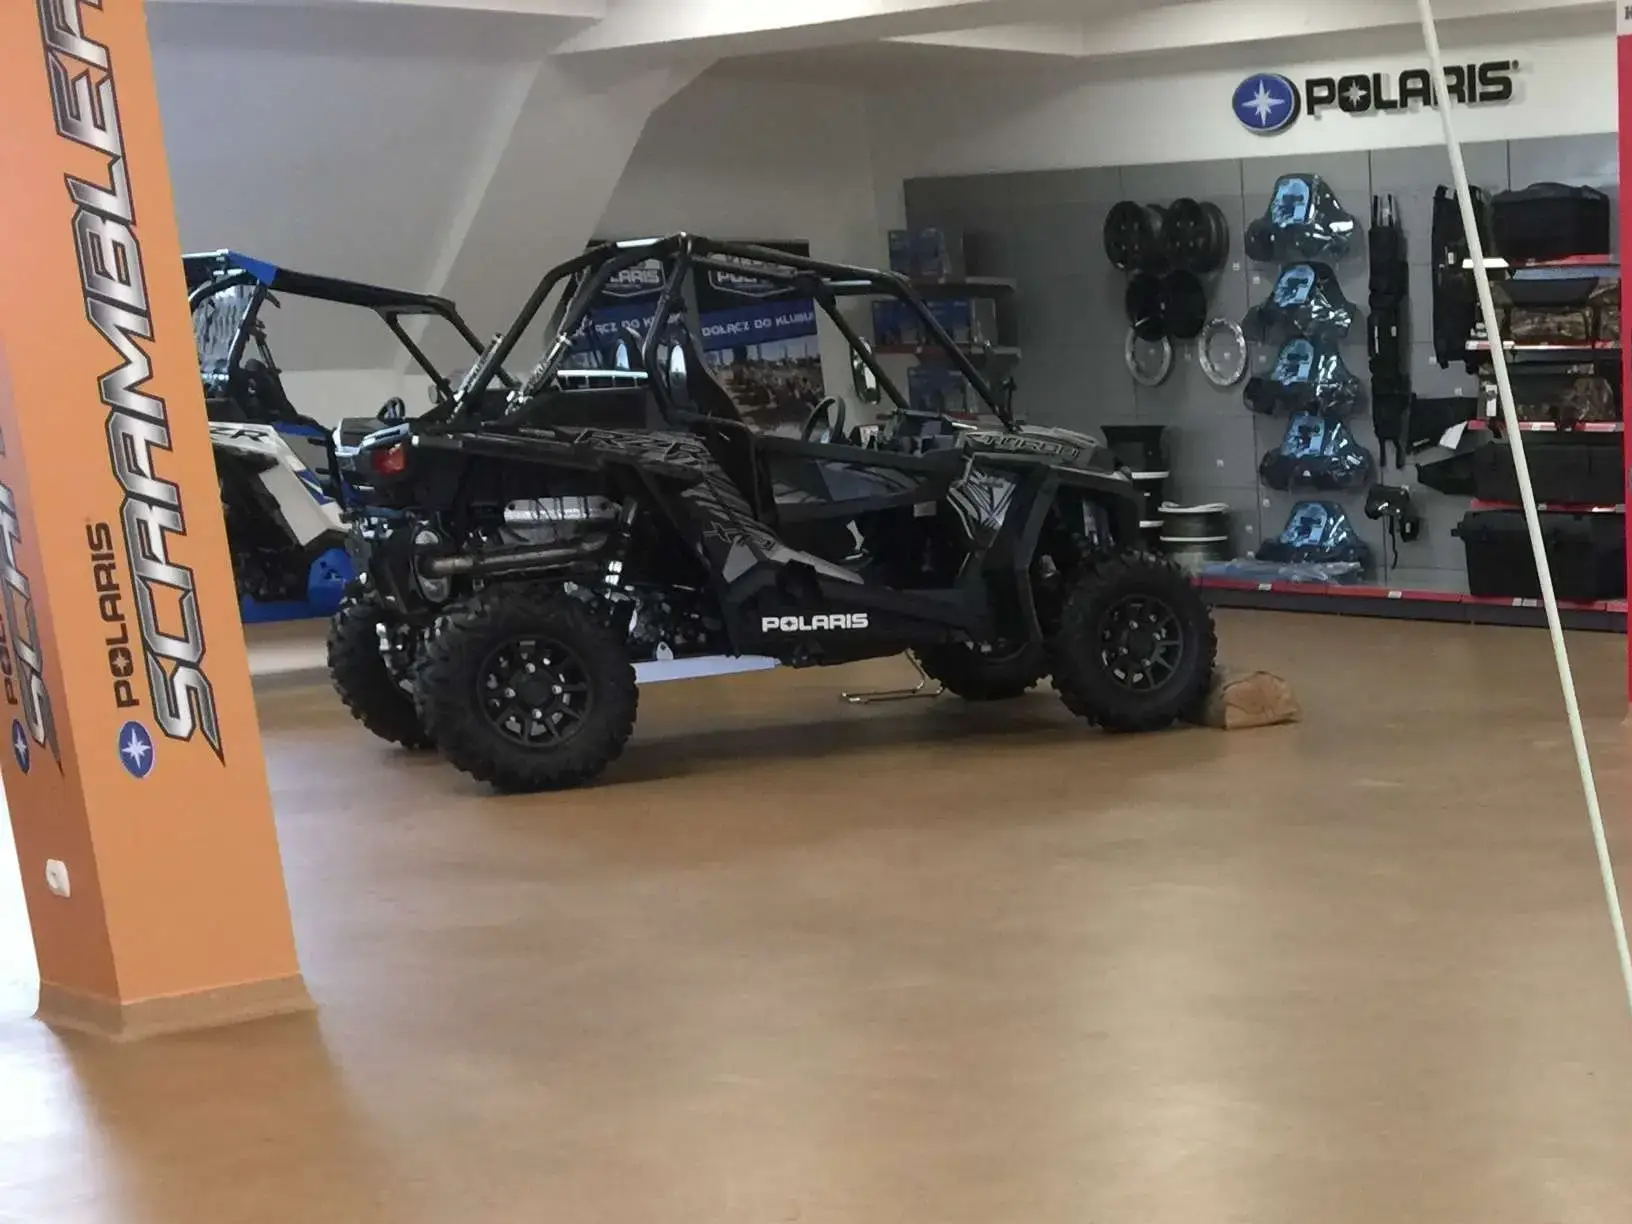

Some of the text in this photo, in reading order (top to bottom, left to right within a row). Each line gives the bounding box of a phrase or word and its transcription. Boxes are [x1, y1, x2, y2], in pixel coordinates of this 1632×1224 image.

[1305, 60, 1514, 116] POLARIS
[754, 318, 772, 330] DO
[85, 520, 140, 708] POLARIS
[762, 612, 869, 633] POLARIS
